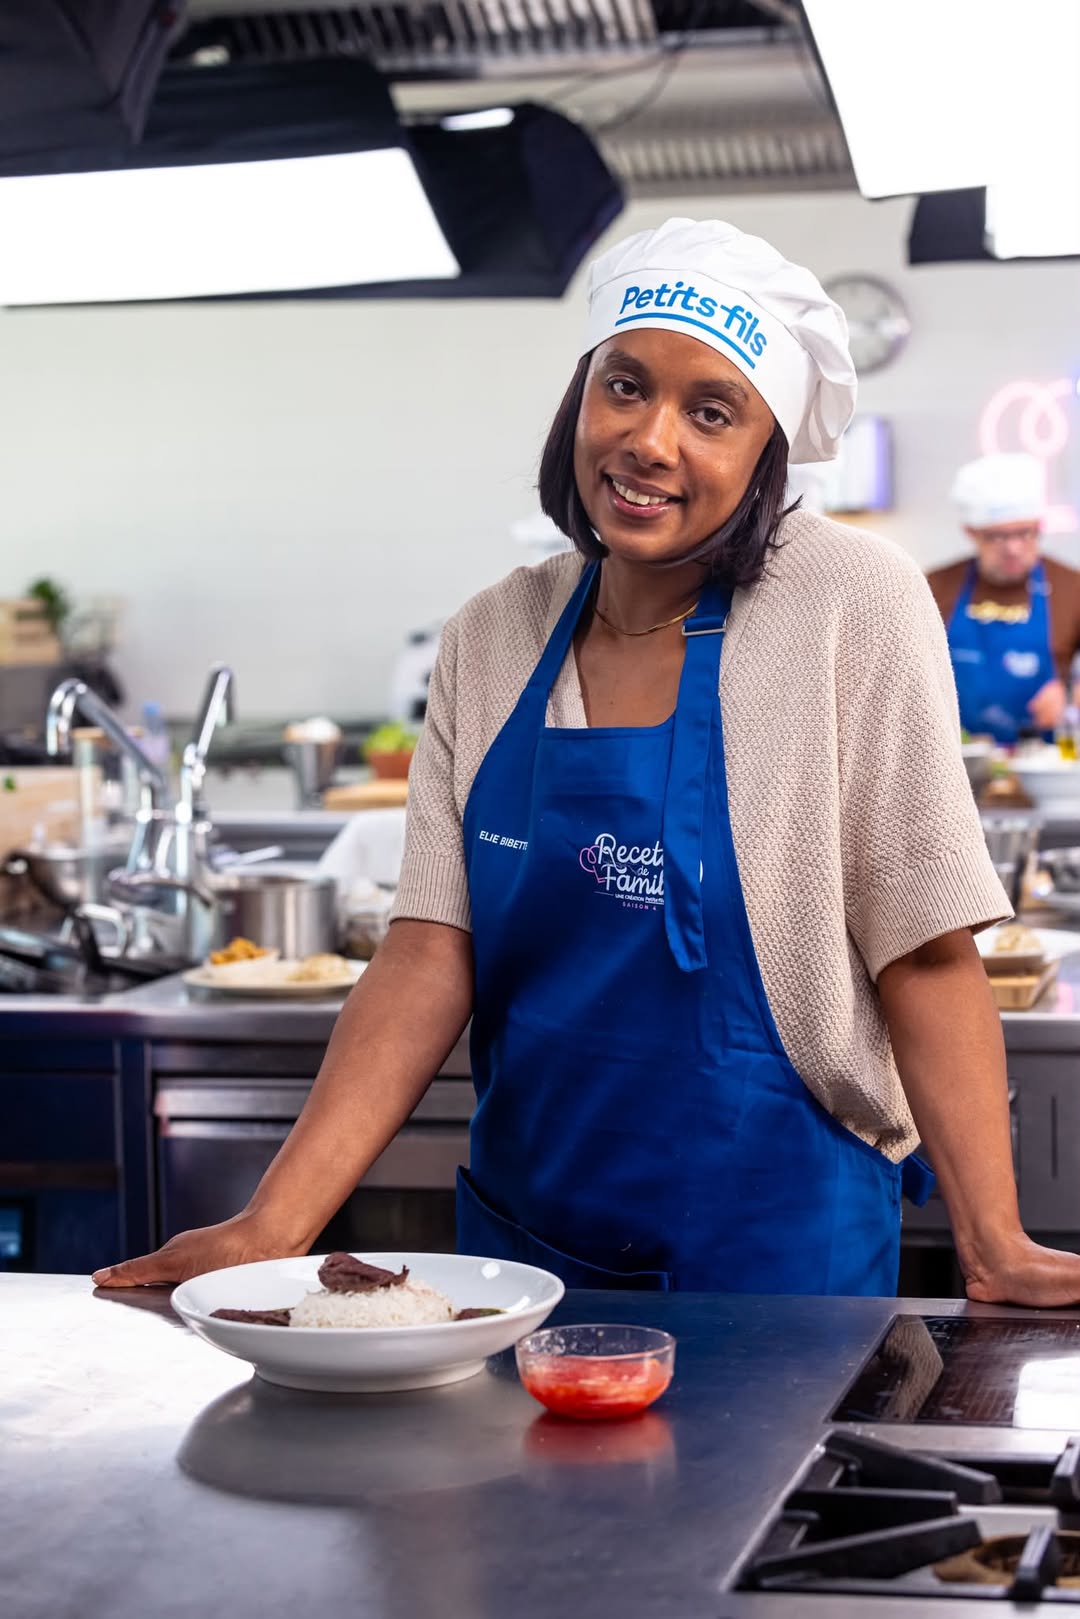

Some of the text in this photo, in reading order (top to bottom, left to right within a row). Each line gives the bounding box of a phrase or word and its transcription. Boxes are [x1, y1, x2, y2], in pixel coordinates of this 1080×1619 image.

[620, 281, 767, 357] Petits-fils
[479, 830, 500, 844] ELIE
[637, 865, 650, 876] de
[622, 901, 649, 910] SAISON
